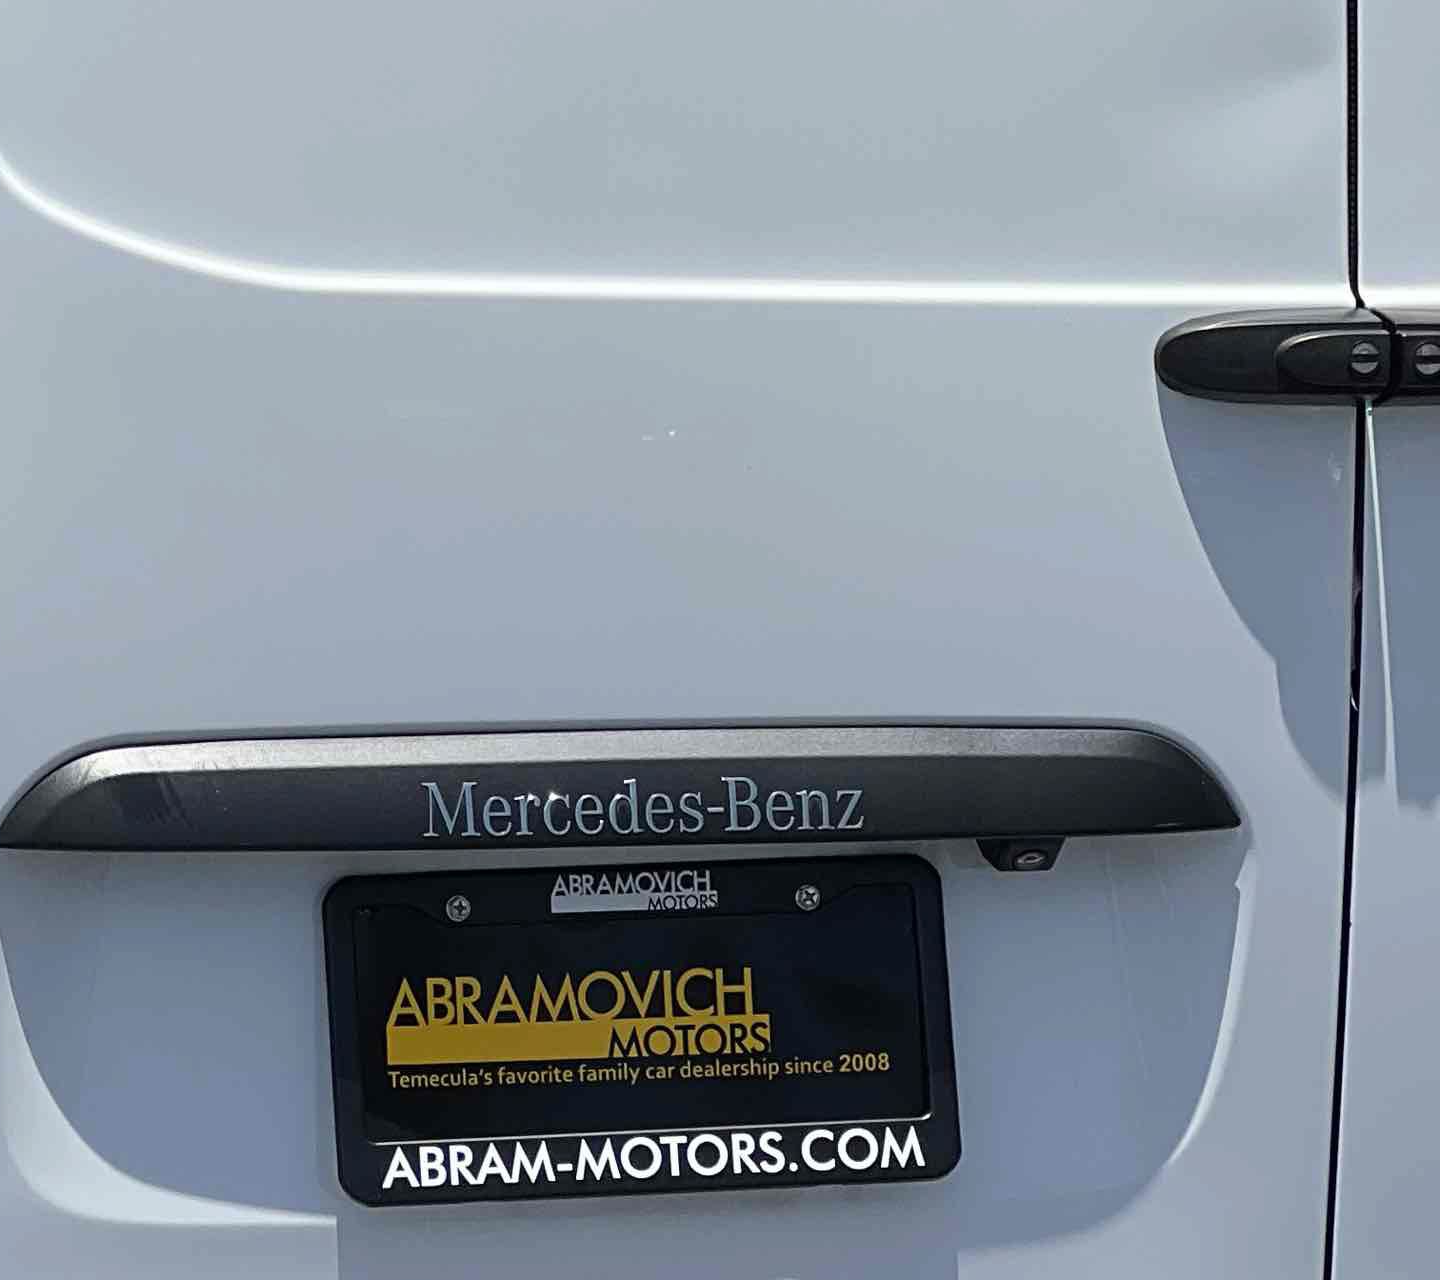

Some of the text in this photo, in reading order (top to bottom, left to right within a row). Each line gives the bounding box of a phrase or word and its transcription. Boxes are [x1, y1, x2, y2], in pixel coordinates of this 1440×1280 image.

[420, 776, 866, 838] Mercedes-Benz
[551, 870, 711, 896] ABRAMOVICH
[648, 893, 717, 911] MOTORS
[389, 967, 754, 1025] ABRAMOVICH
[608, 1022, 771, 1058] MOTORS
[388, 1053, 891, 1089] Temecula's favorite family car dealership since 2008
[382, 1126, 927, 1190] ABRAM-MOTORS.COM
